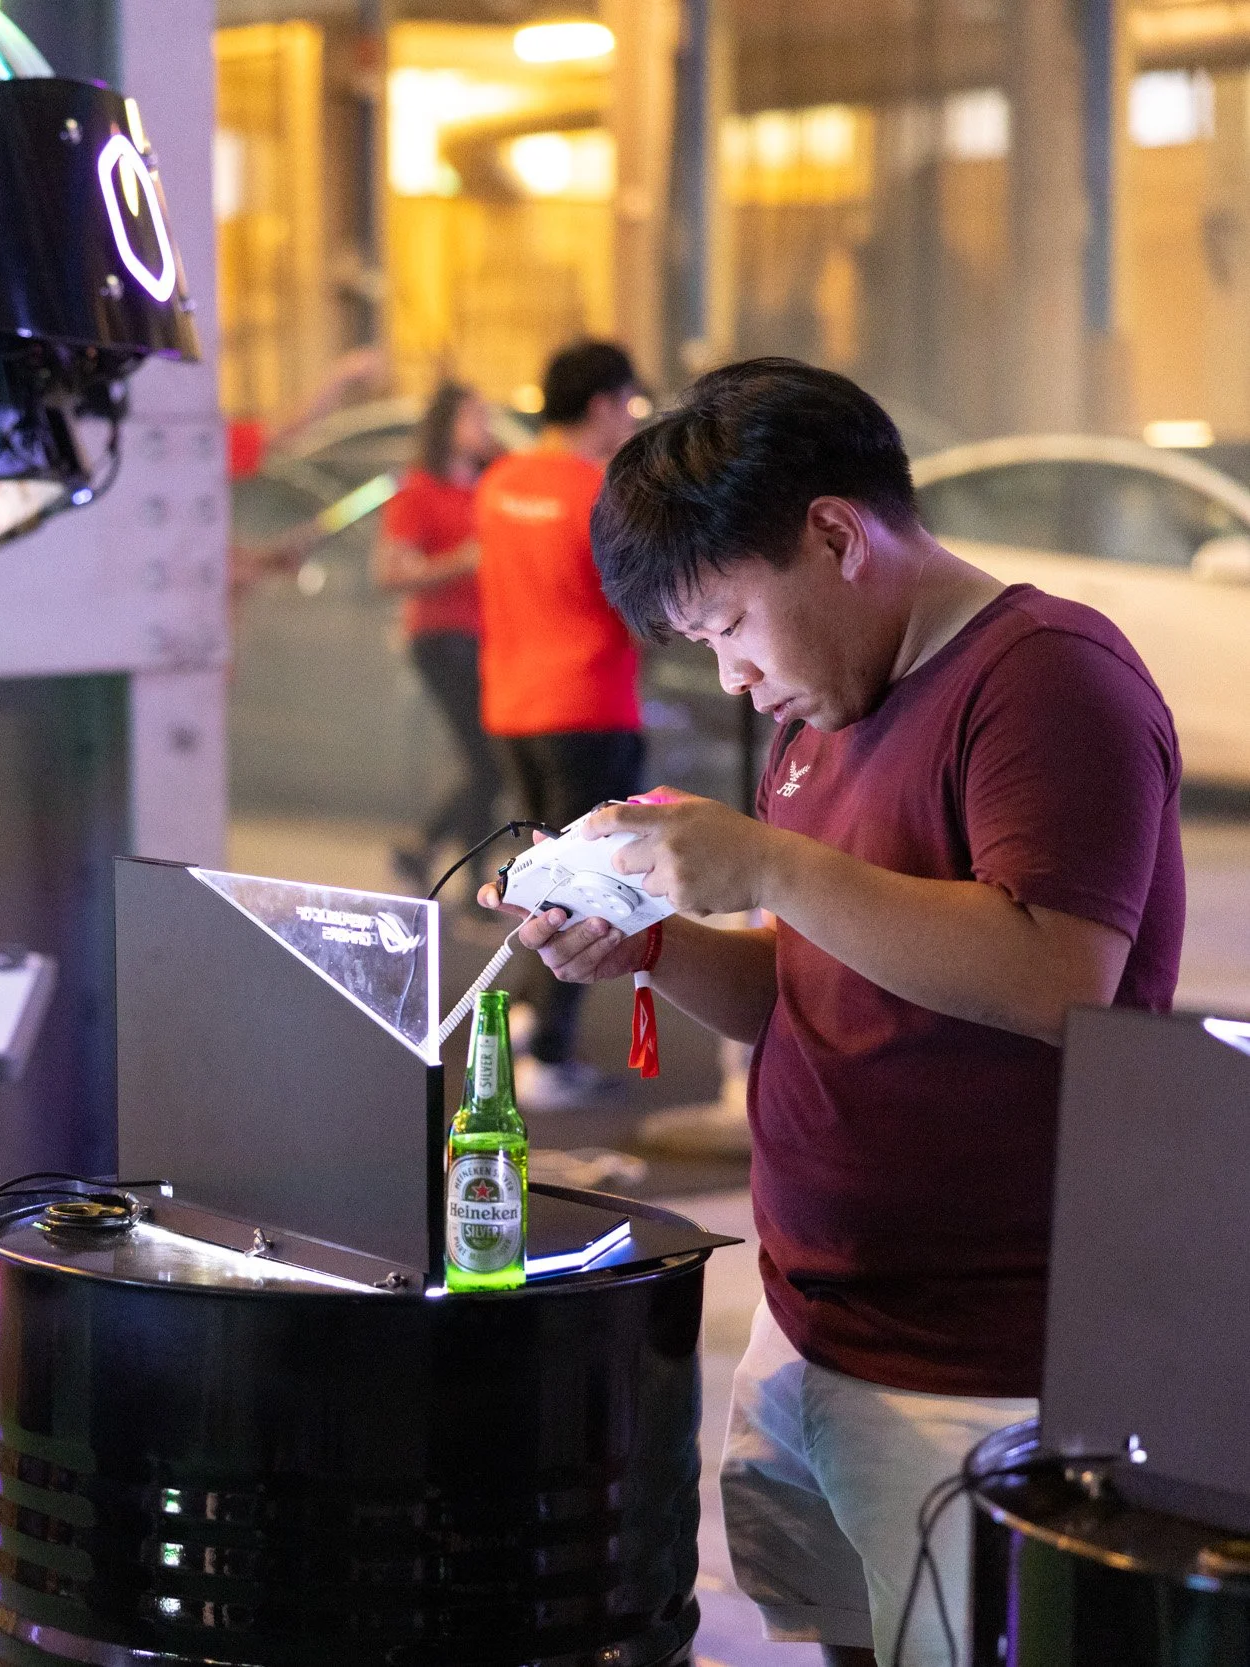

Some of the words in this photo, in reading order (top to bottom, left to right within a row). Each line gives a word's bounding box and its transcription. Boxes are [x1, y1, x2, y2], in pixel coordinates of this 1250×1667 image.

[479, 1053, 493, 1089] SILVER
[455, 1165, 493, 1190] HEINEKEN
[449, 1202, 518, 1221] Heineken
[464, 1224, 501, 1238] SILVER
